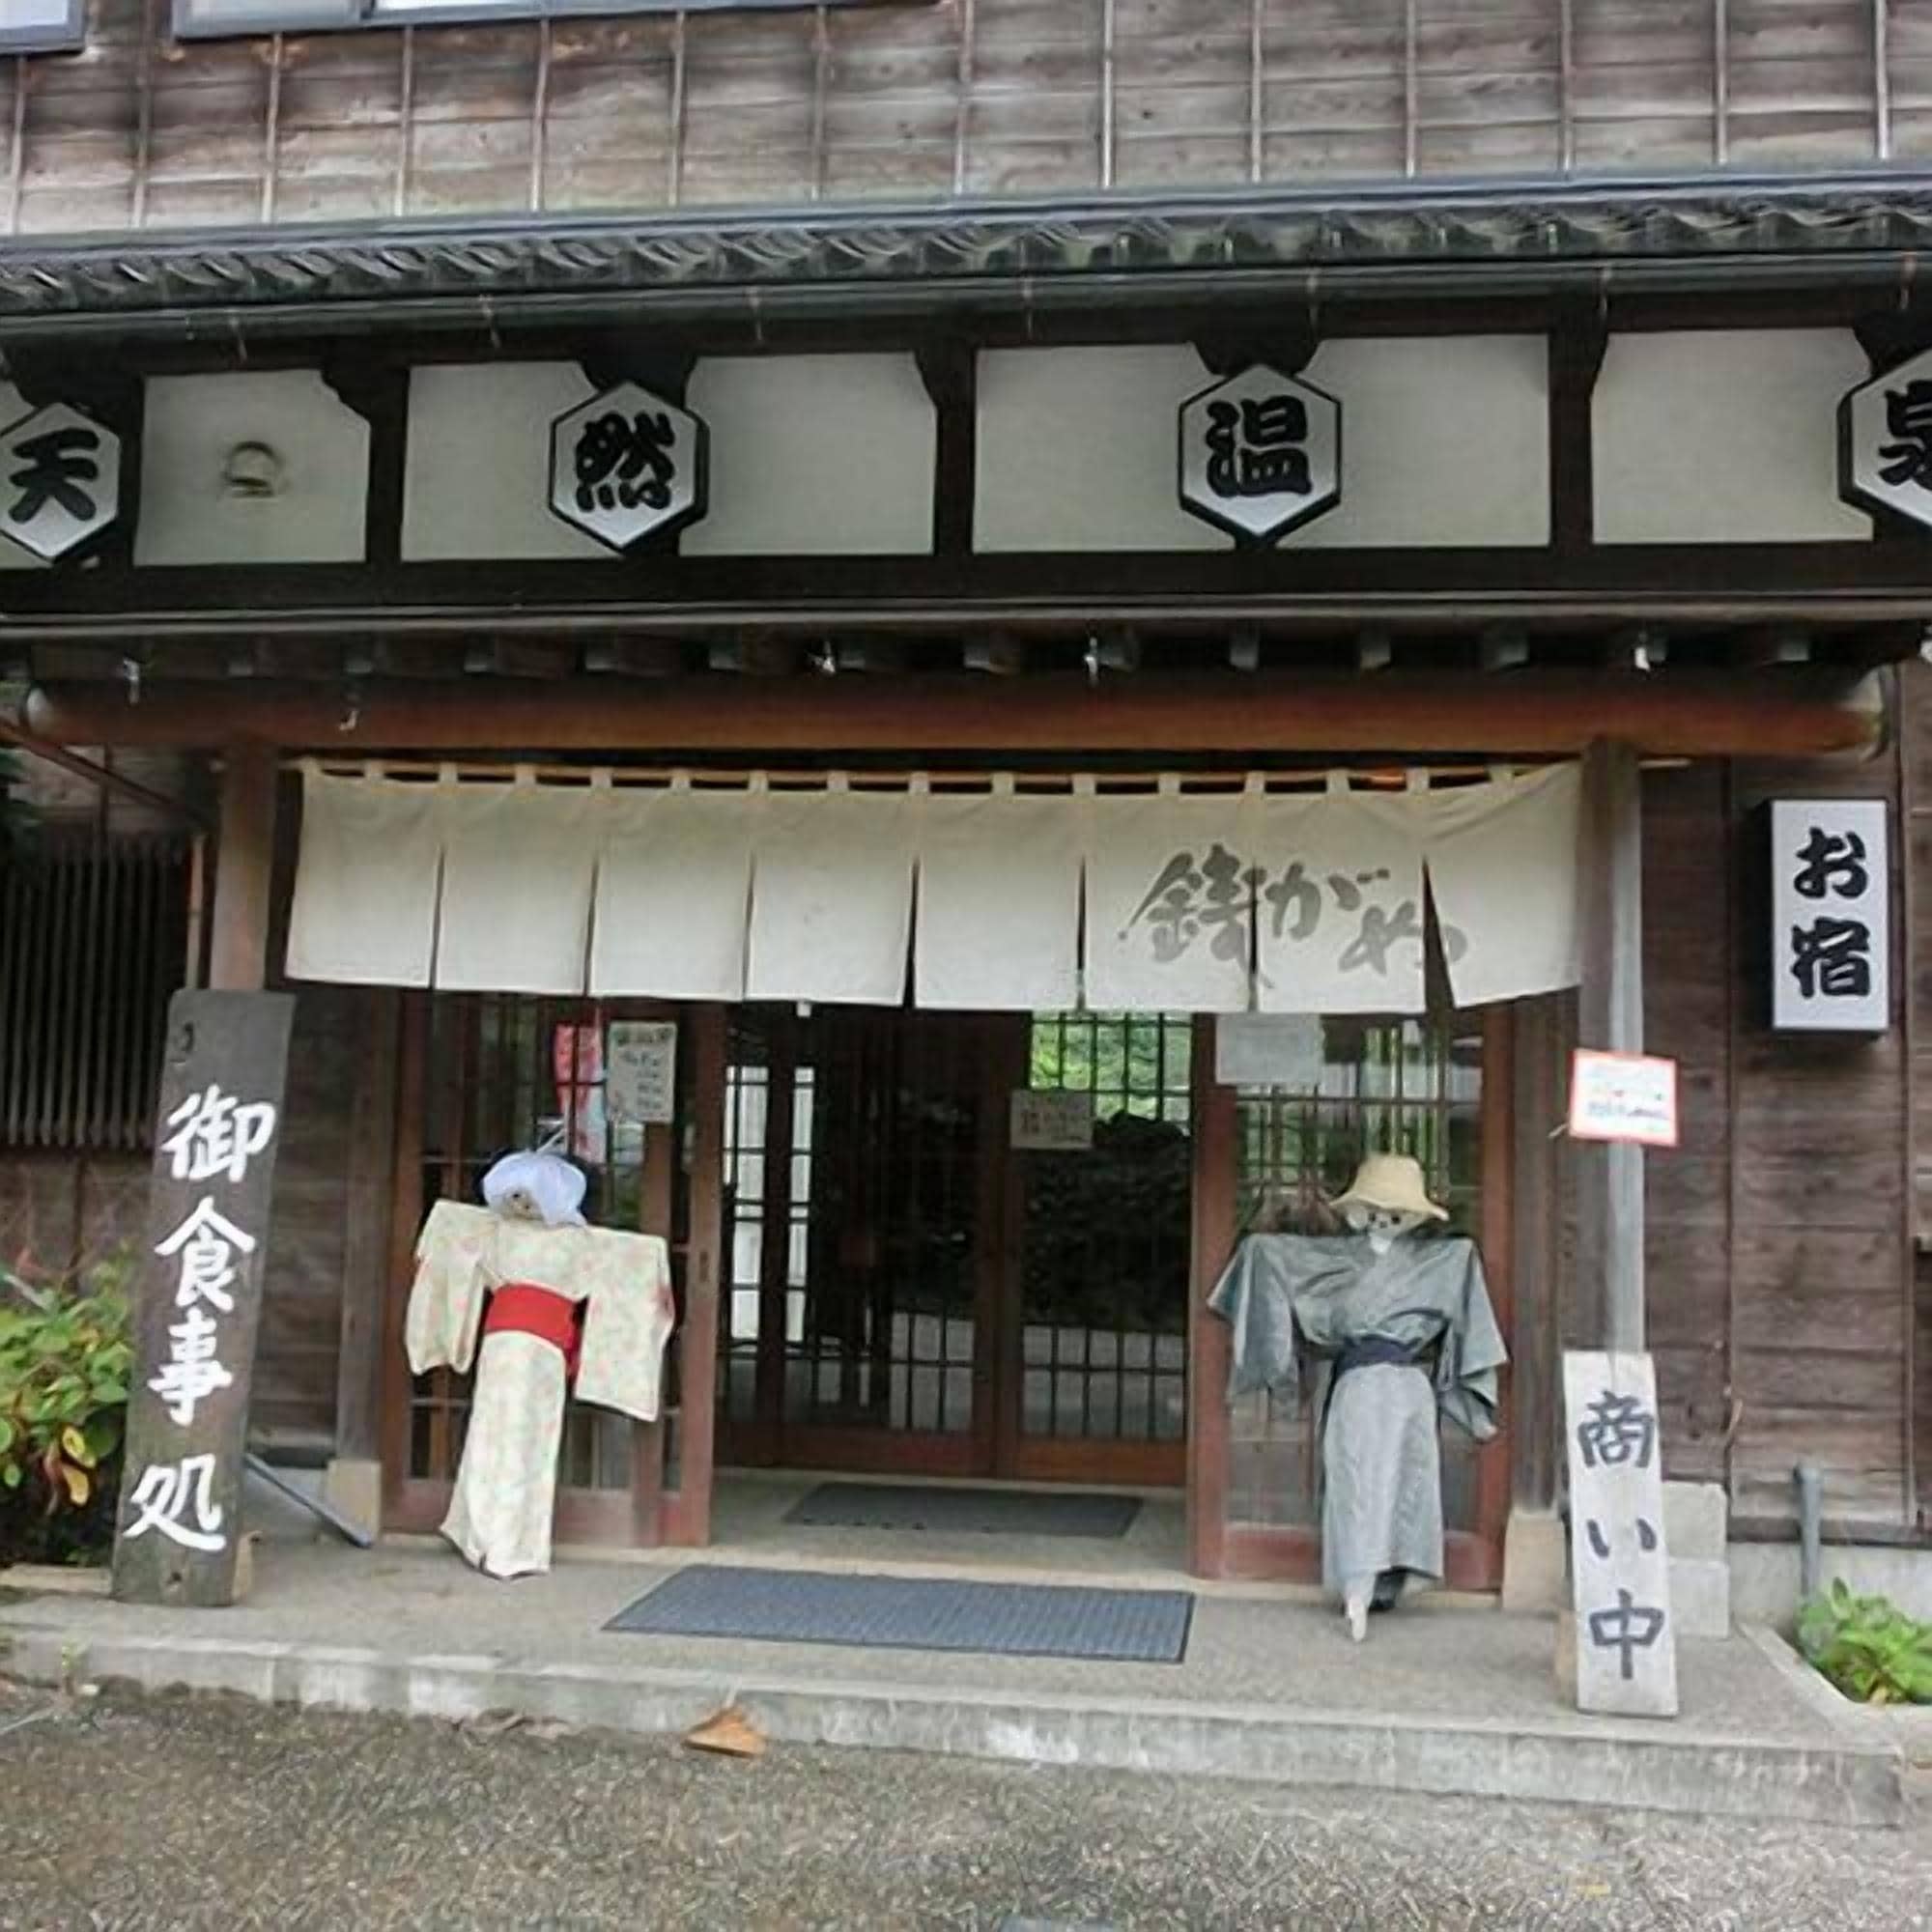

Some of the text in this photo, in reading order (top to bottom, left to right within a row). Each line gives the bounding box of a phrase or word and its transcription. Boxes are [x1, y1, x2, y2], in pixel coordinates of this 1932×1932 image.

[9, 428, 99, 523] 天
[574, 411, 675, 512] 然
[1205, 394, 1313, 499] 温
[1790, 826, 1871, 1000] お宿
[123, 1083, 277, 1552] 御食事処
[1577, 1389, 1666, 1681] 商い中
